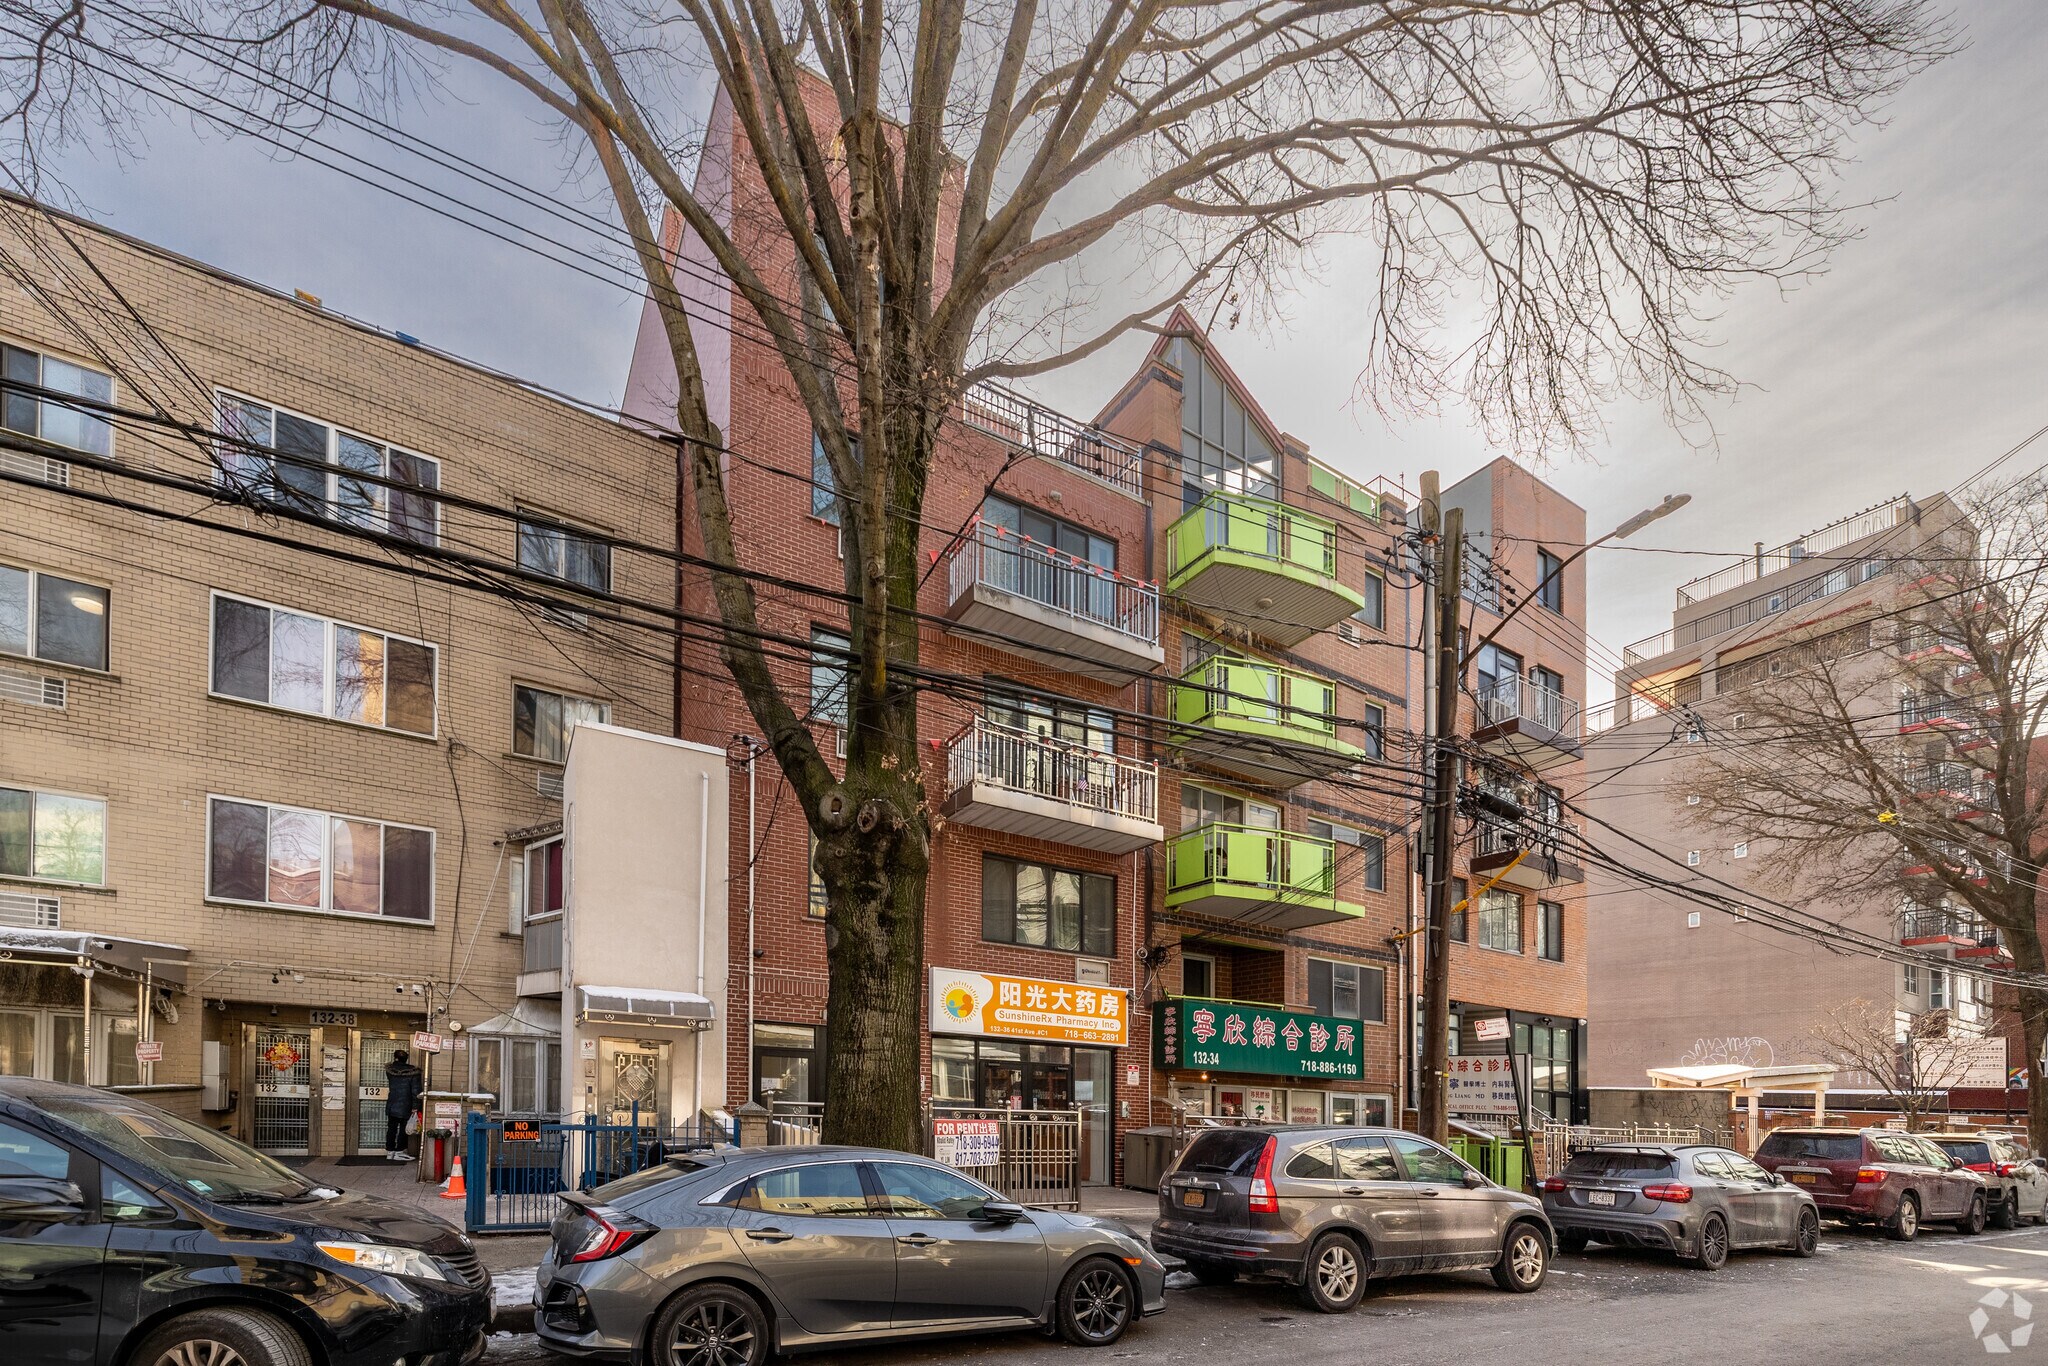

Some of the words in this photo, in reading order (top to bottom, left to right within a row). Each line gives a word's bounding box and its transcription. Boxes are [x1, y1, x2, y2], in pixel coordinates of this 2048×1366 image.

[999, 981, 1119, 1016] 阳光大药房
[311, 1011, 355, 1025] 132-38
[998, 1010, 1052, 1024] SunshineRx
[1056, 1016, 1099, 1029] Pharmacy
[1102, 1019, 1118, 1029] Inc.
[990, 1025, 1011, 1033] 132-36
[418, 1034, 428, 1042] NO
[1064, 1029, 1119, 1042] 718-663-2891
[416, 1040, 439, 1050] PARKING
[1193, 1050, 1220, 1065] 132-34
[1301, 1060, 1357, 1075] 718-886-1150
[260, 1083, 278, 1092] 132
[364, 1087, 381, 1096] 132
[514, 1121, 529, 1131] NO
[936, 1122, 955, 1134] FOR
[957, 1122, 979, 1134] RENT
[979, 1122, 998, 1134] 出租
[504, 1130, 540, 1140] PARKING
[955, 1135, 999, 1150] 718-309-6944
[955, 1151, 998, 1166] 917-703-3737
